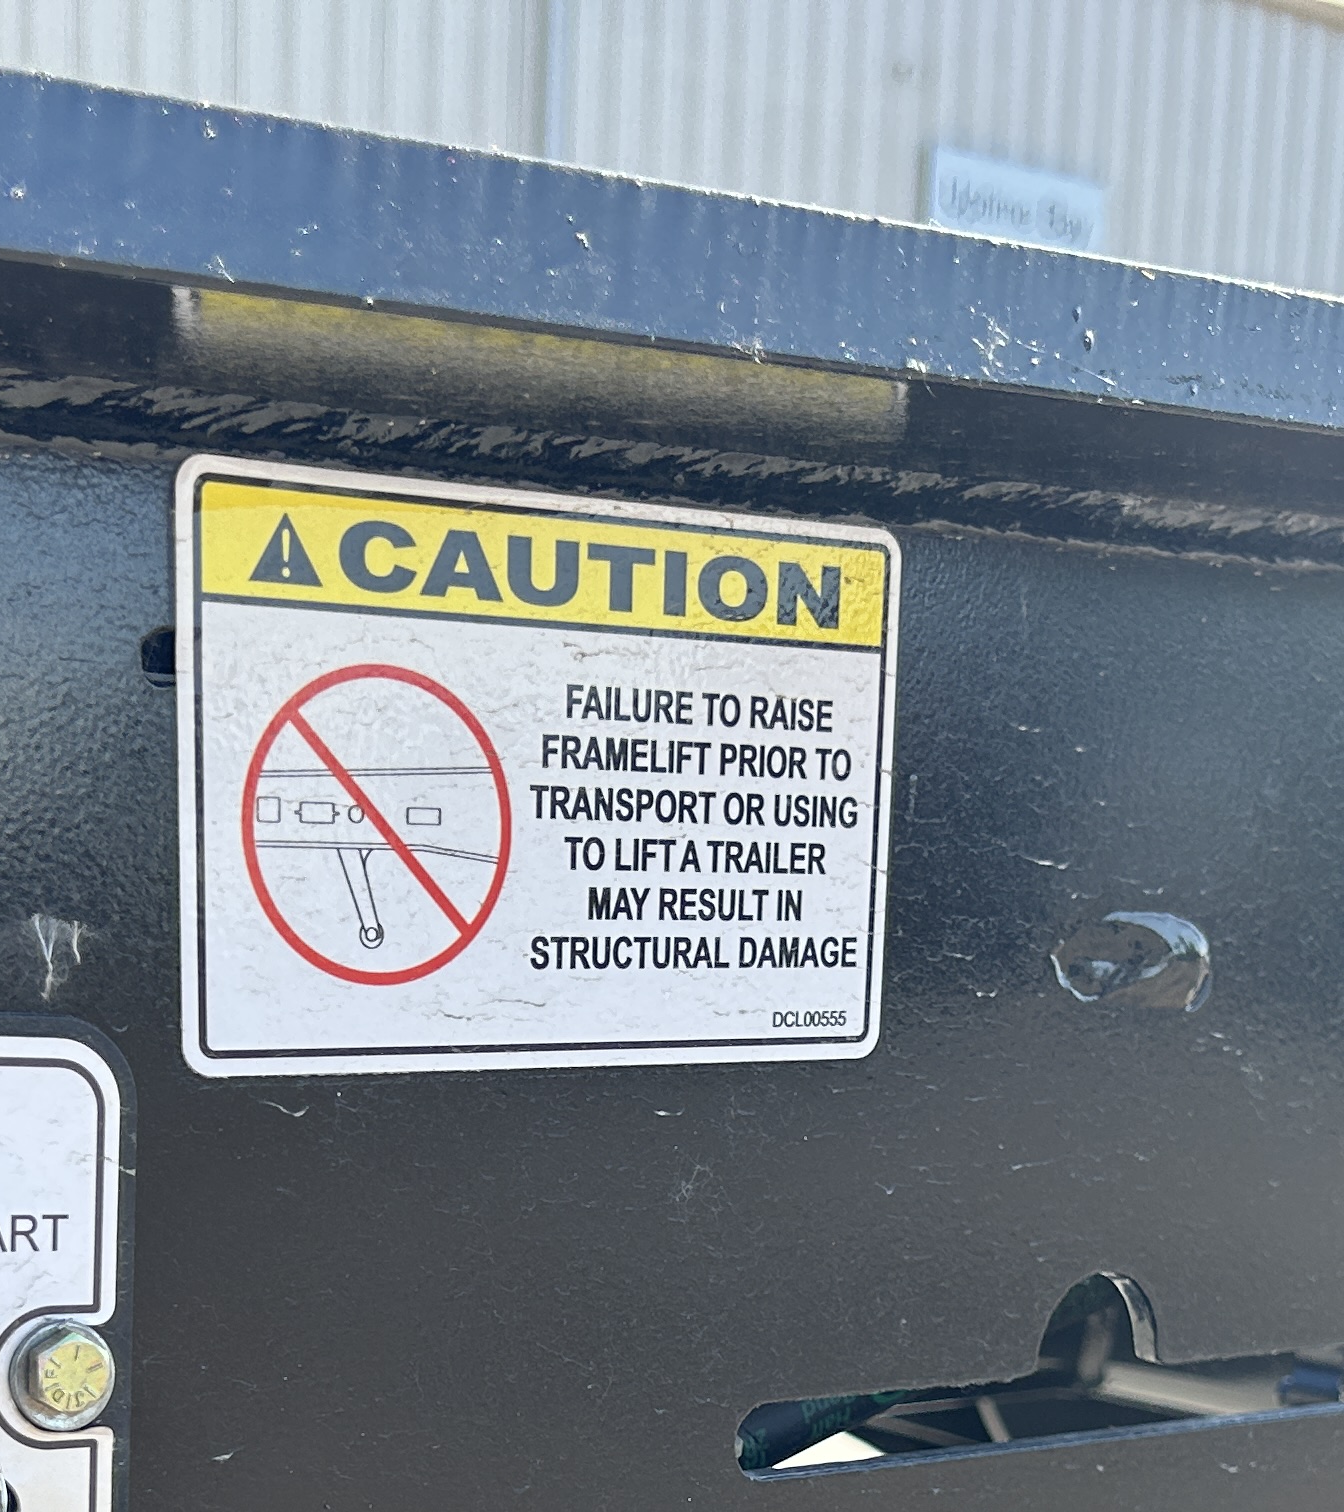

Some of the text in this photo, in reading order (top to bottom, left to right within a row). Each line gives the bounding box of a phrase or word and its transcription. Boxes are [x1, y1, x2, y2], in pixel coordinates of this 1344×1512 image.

[338, 520, 843, 631] CAUTION
[565, 683, 834, 733] FAILURE TO RAISE
[541, 734, 853, 781] FRAMELIFT PRIOR TO
[529, 784, 859, 829] TRANSPORT OR USING
[564, 836, 827, 876] TO LIFT A TRAILER
[587, 886, 803, 922] MAY RESULT IN
[529, 935, 858, 970] STRUCTURAL DAMAGE
[771, 1010, 848, 1029] DCL00555
